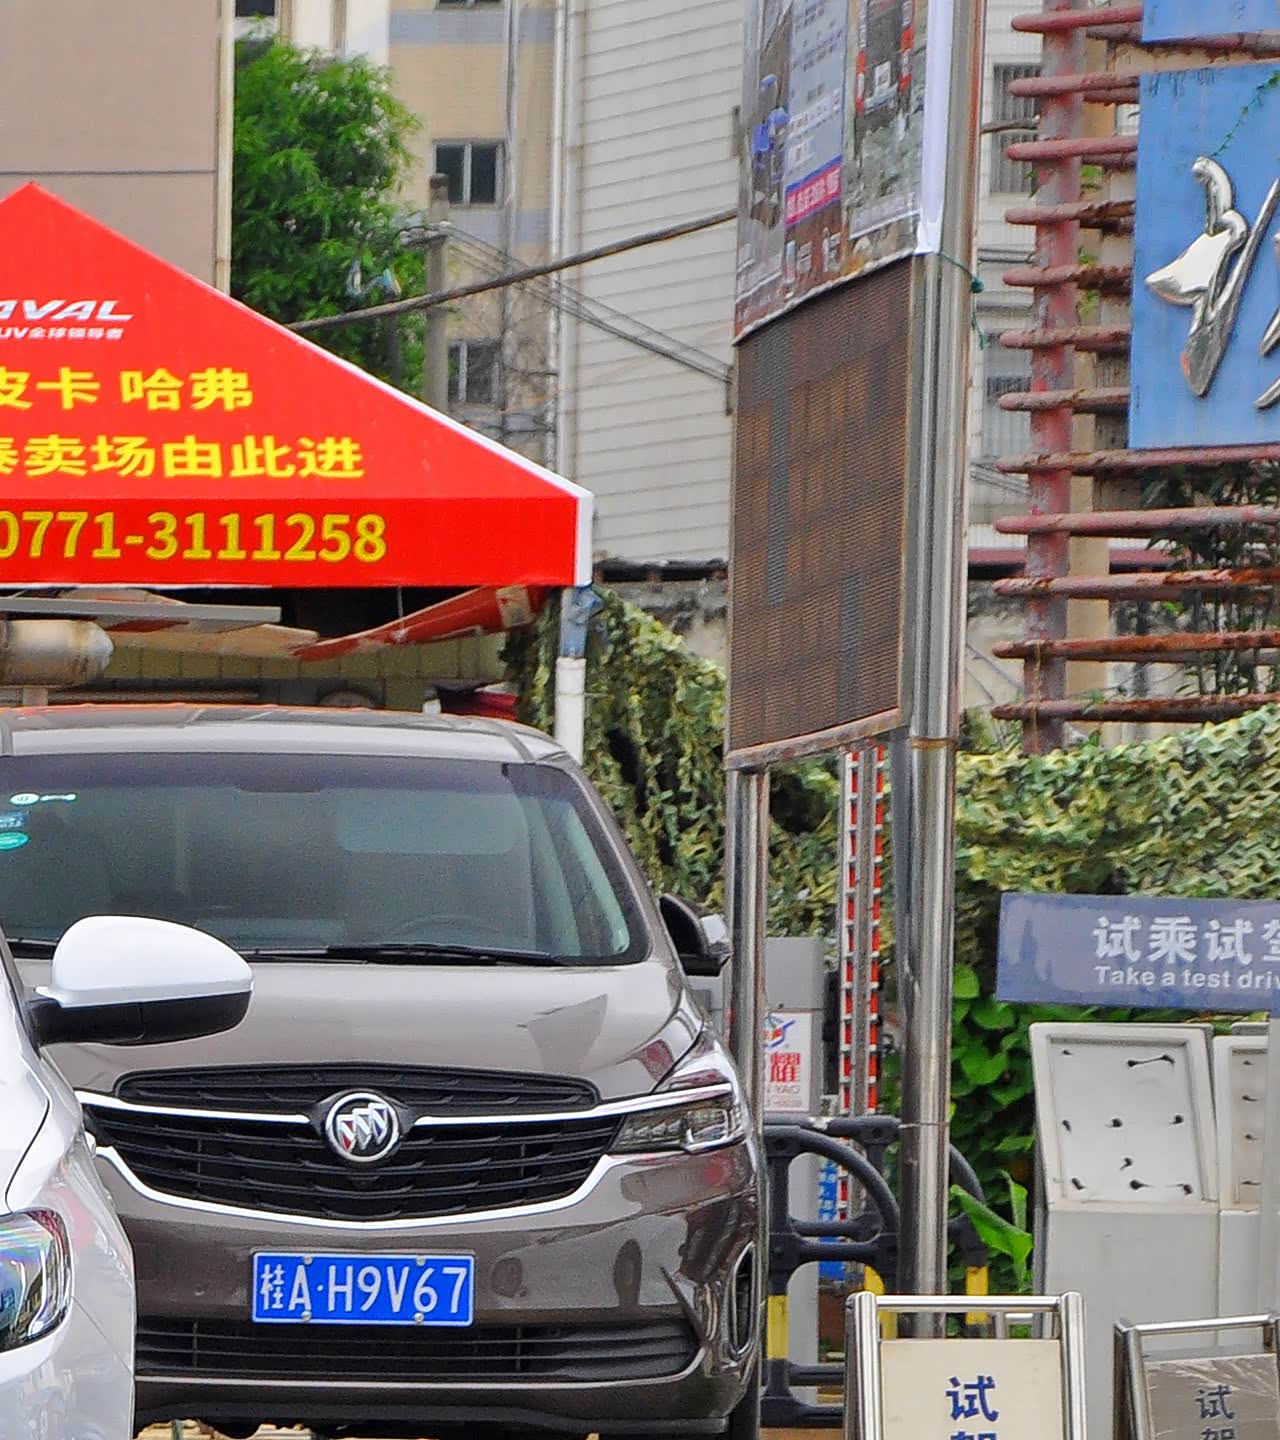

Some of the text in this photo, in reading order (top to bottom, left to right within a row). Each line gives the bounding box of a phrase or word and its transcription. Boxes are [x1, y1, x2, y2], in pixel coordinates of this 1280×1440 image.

[121, 367, 253, 410] 哈弗
[1094, 965, 1155, 986] Take
[1161, 973, 1176, 986] a
[1183, 969, 1230, 988] test
[260, 1264, 468, 1314] 桂A·H9V67
